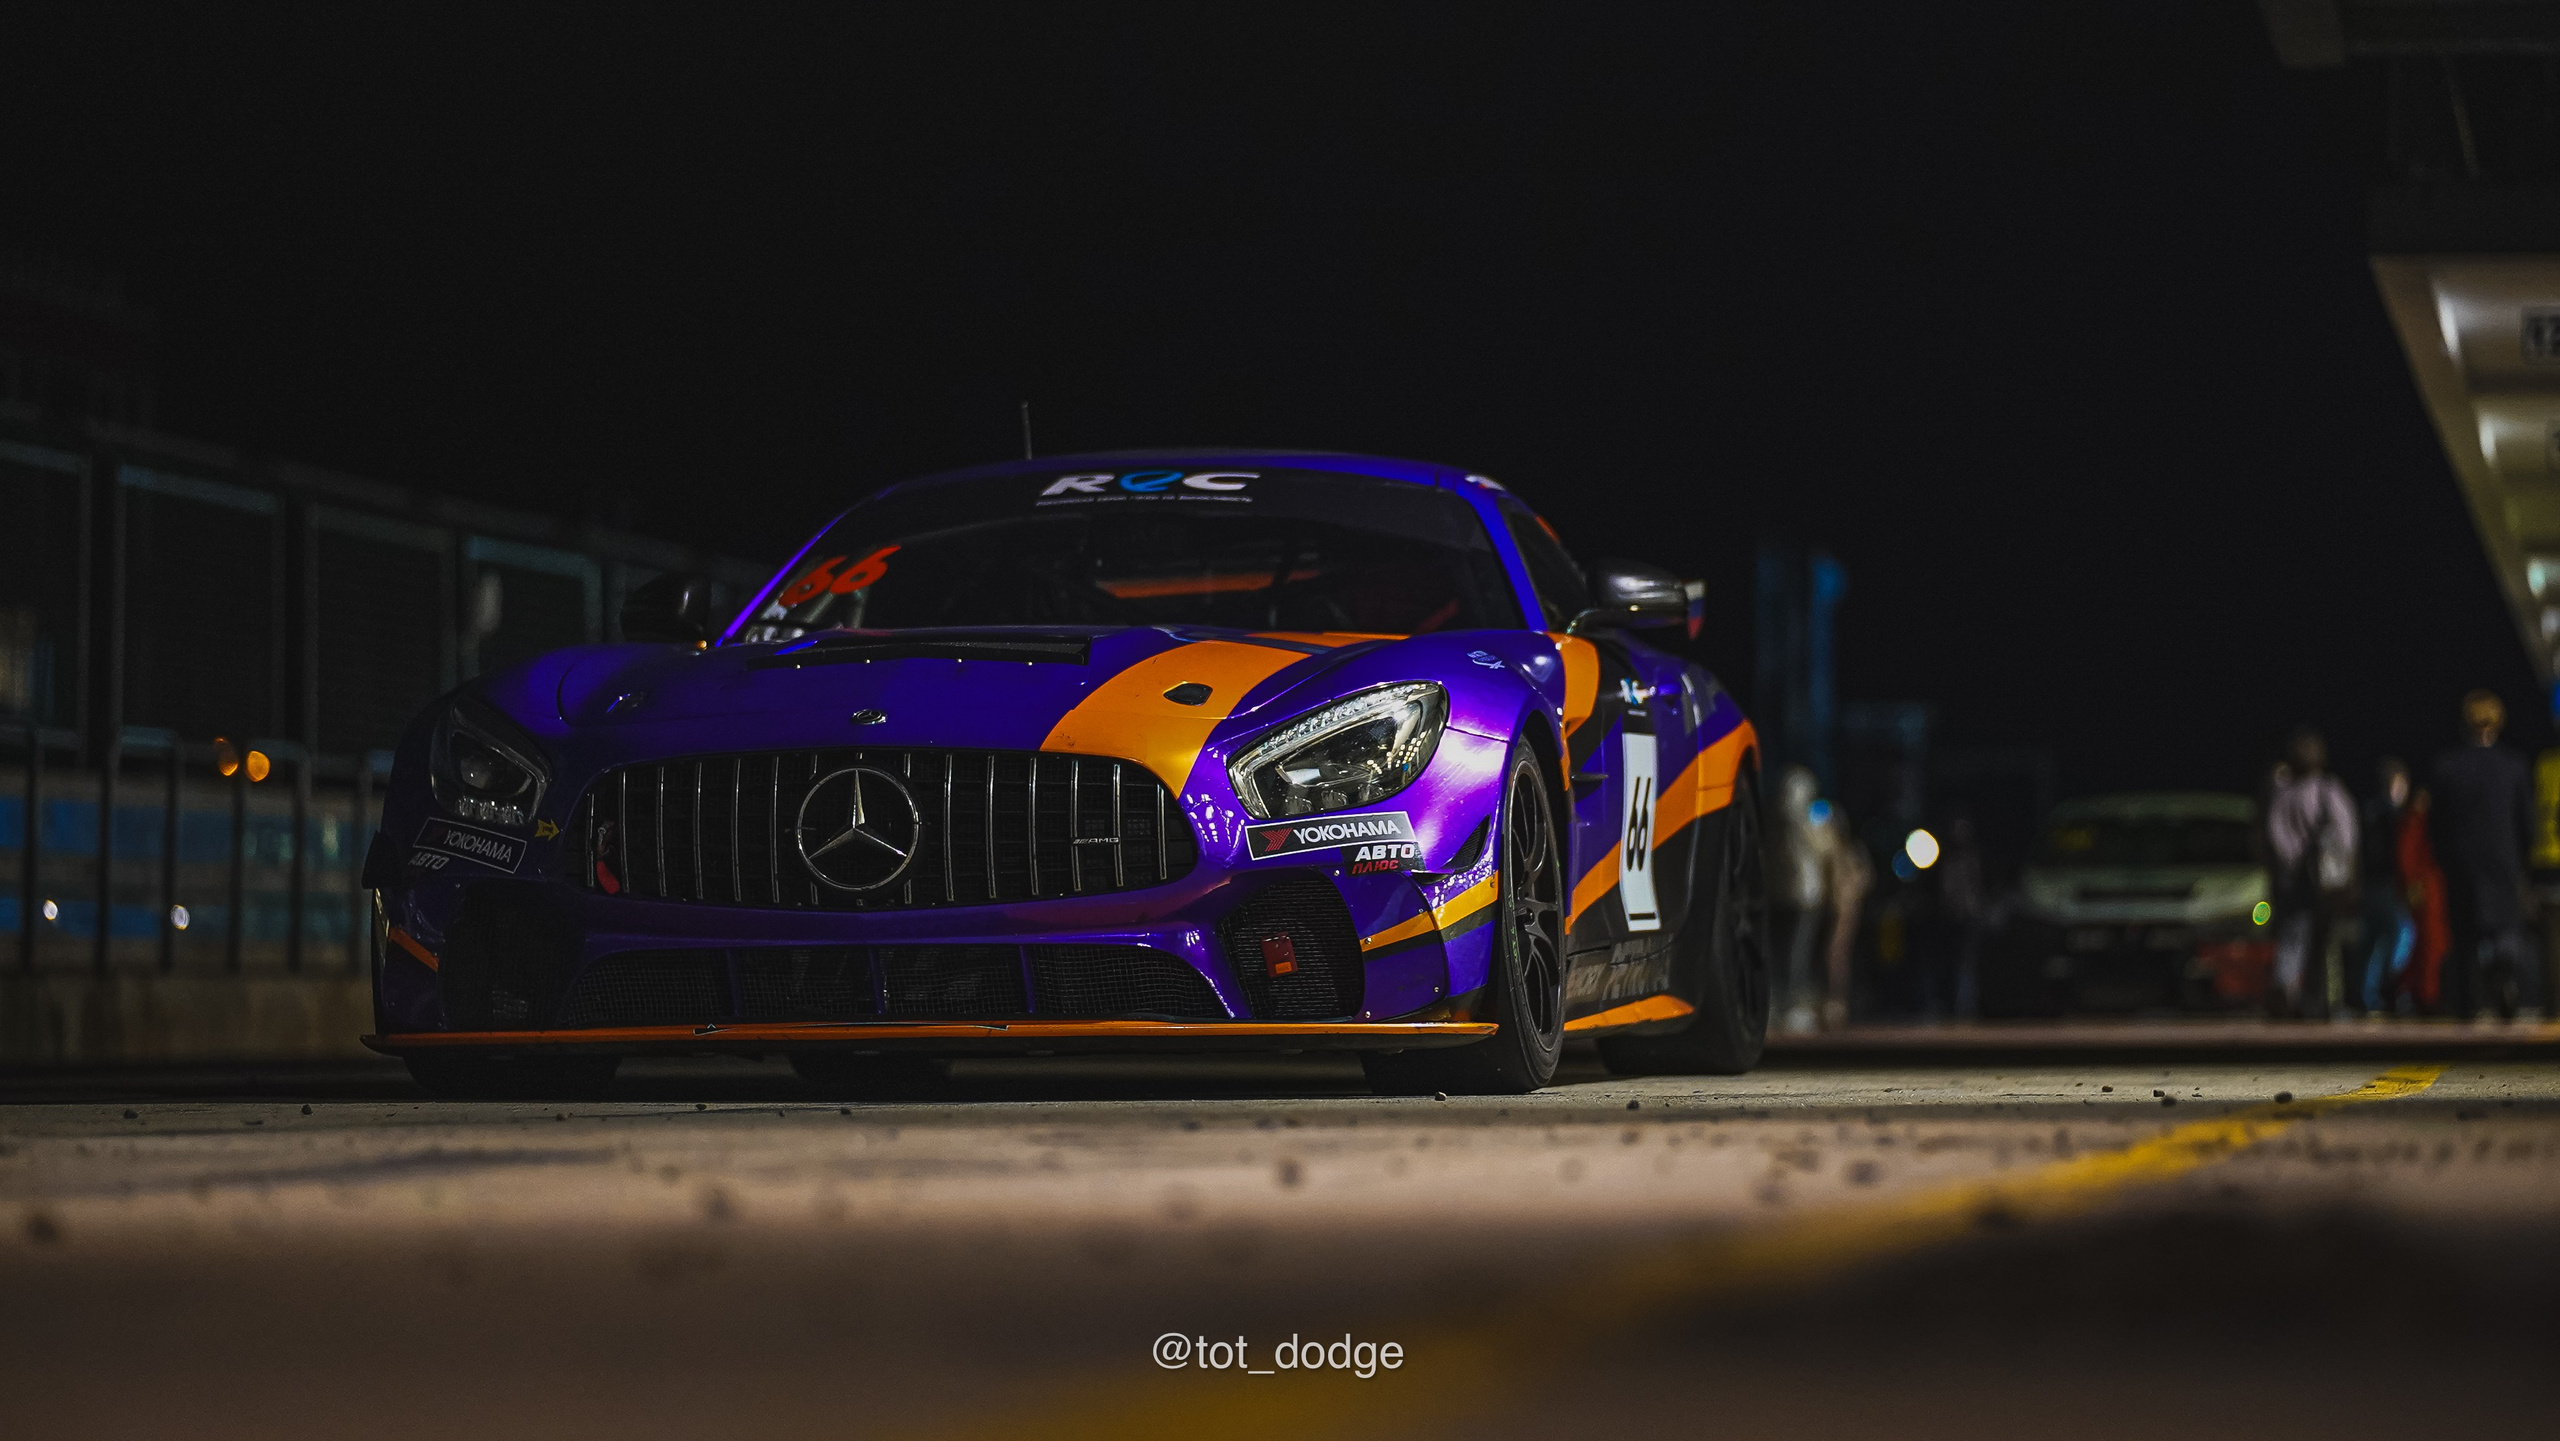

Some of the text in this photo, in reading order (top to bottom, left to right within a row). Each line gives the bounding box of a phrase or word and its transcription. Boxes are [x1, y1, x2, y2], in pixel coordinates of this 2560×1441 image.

[778, 543, 902, 608] 66
[1292, 819, 1402, 845] YOKOHAMA
[1626, 776, 1651, 872] 66
[443, 829, 513, 863] YOKOHAMA
[1088, 836, 1119, 844] AMG
[408, 851, 450, 870] АВТО
[1354, 843, 1415, 863] АВТО
[1351, 859, 1399, 875] ПЛЮС
